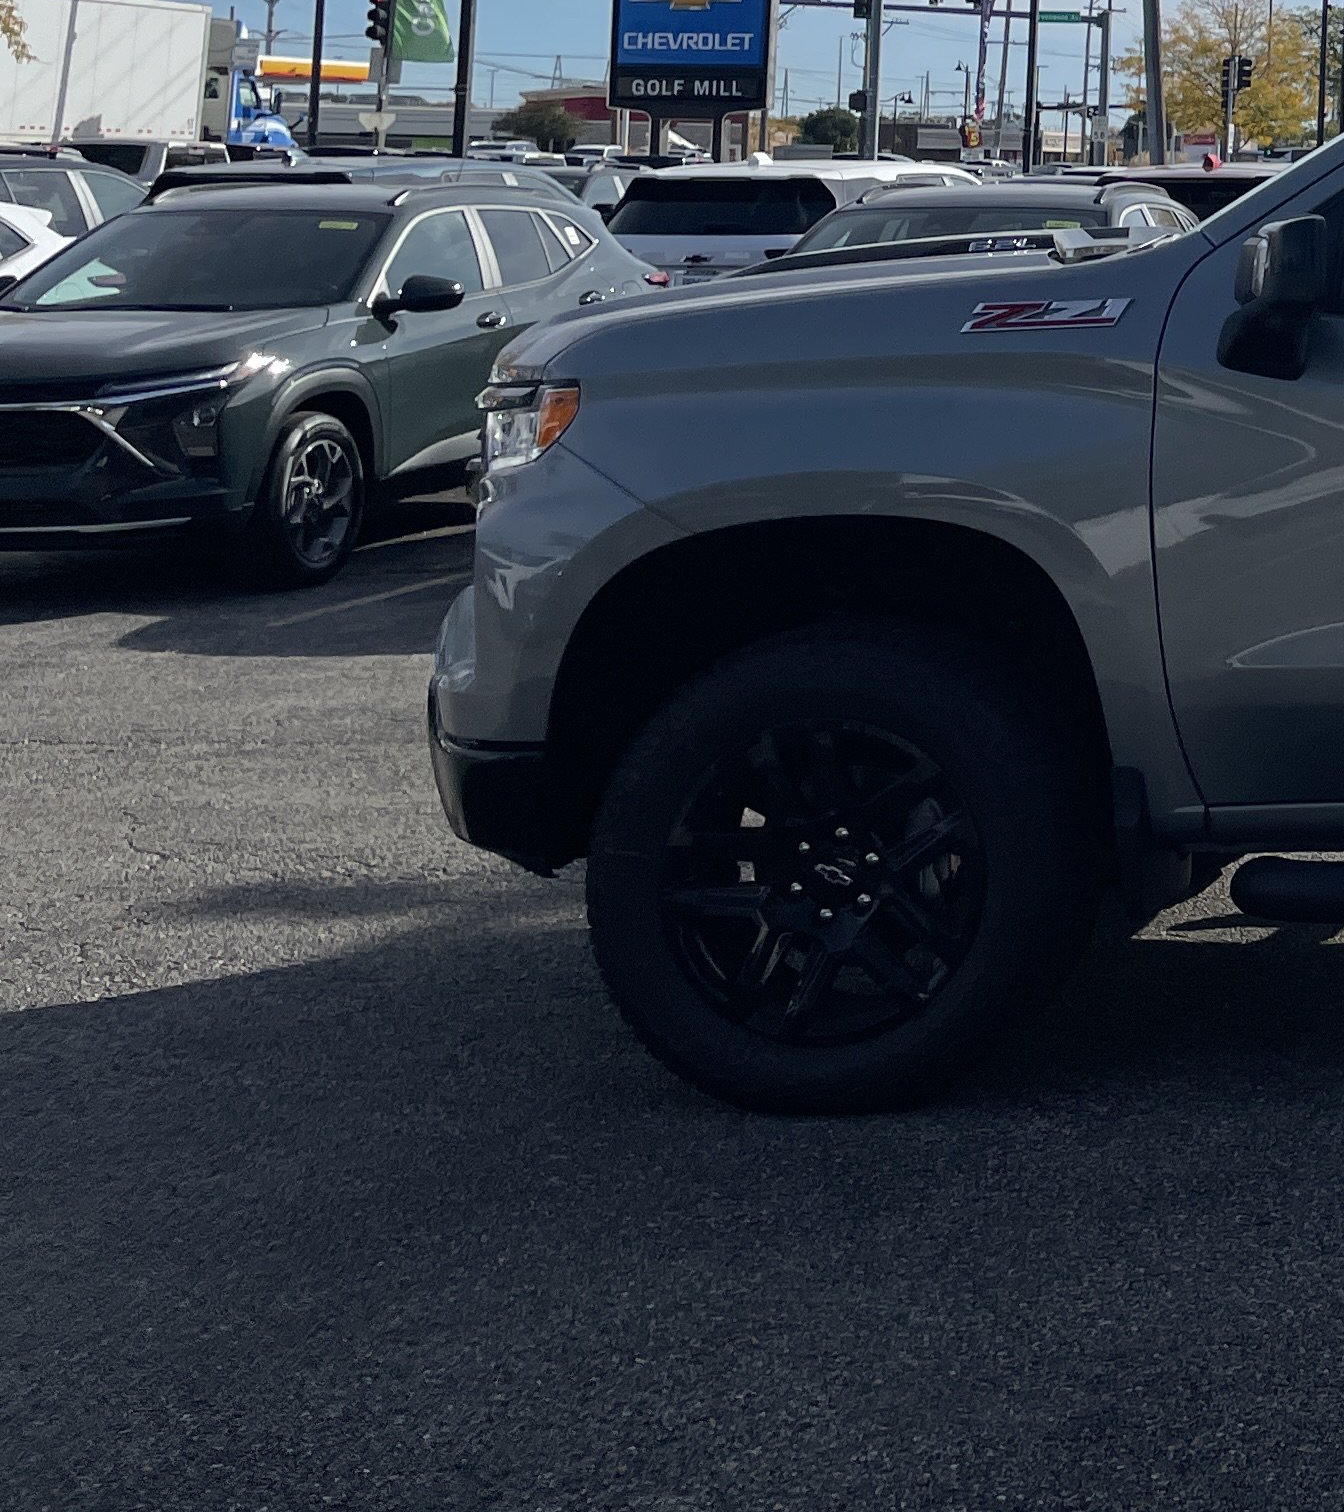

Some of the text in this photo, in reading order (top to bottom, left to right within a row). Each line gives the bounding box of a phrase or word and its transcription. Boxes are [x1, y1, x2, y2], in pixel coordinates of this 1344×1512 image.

[623, 32, 754, 51] CHEVROLET
[631, 79, 742, 96] GOLF MILL
[960, 297, 1133, 333] Z71
